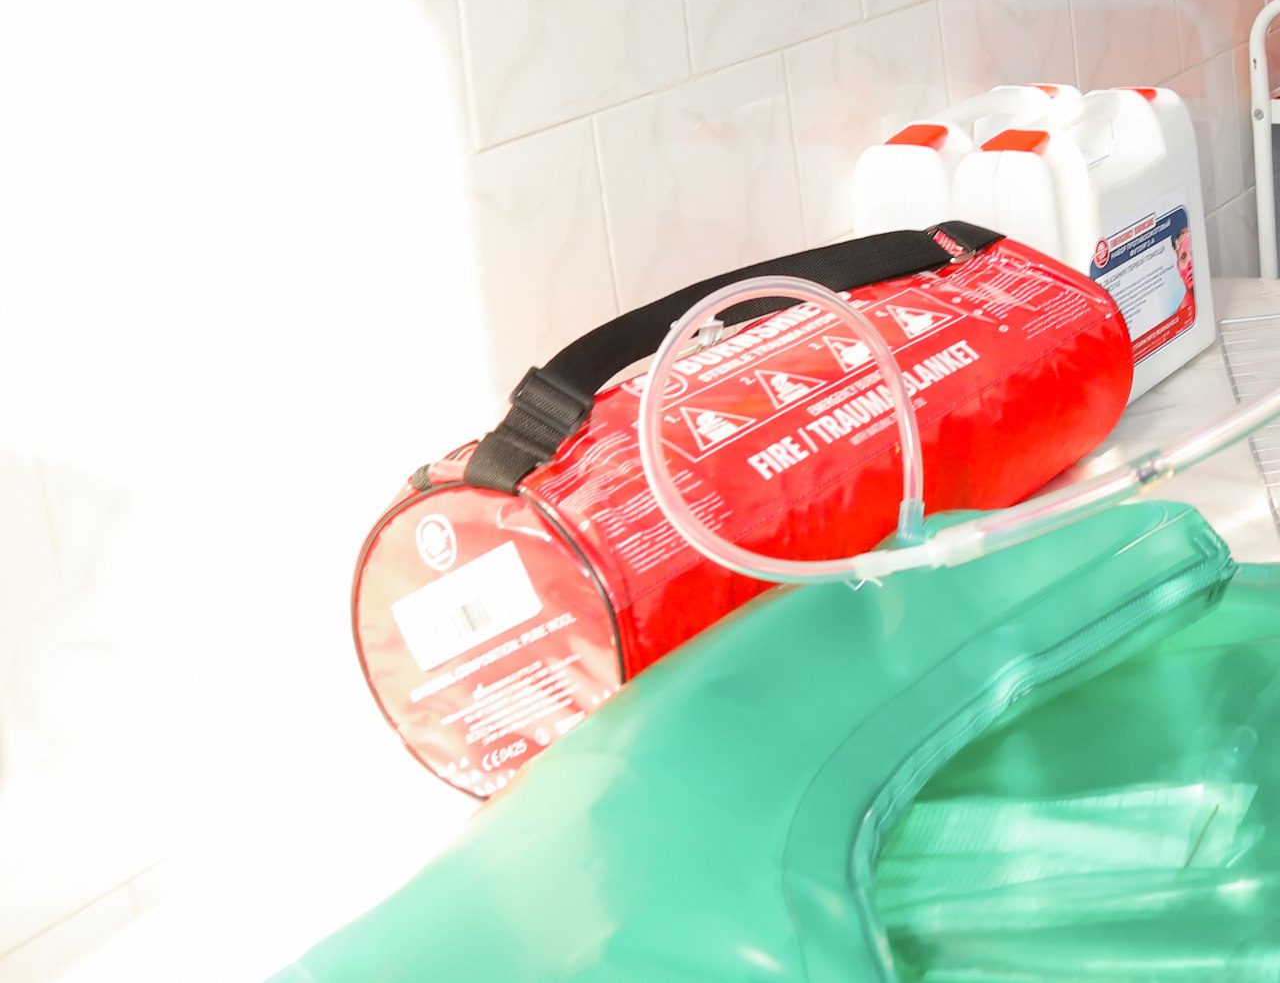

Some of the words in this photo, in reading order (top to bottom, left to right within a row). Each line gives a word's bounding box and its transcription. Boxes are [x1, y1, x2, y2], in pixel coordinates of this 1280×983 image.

[747, 434, 810, 481] FIRE
[808, 383, 899, 445] TRAUMA
[904, 339, 980, 399] BLANKET
